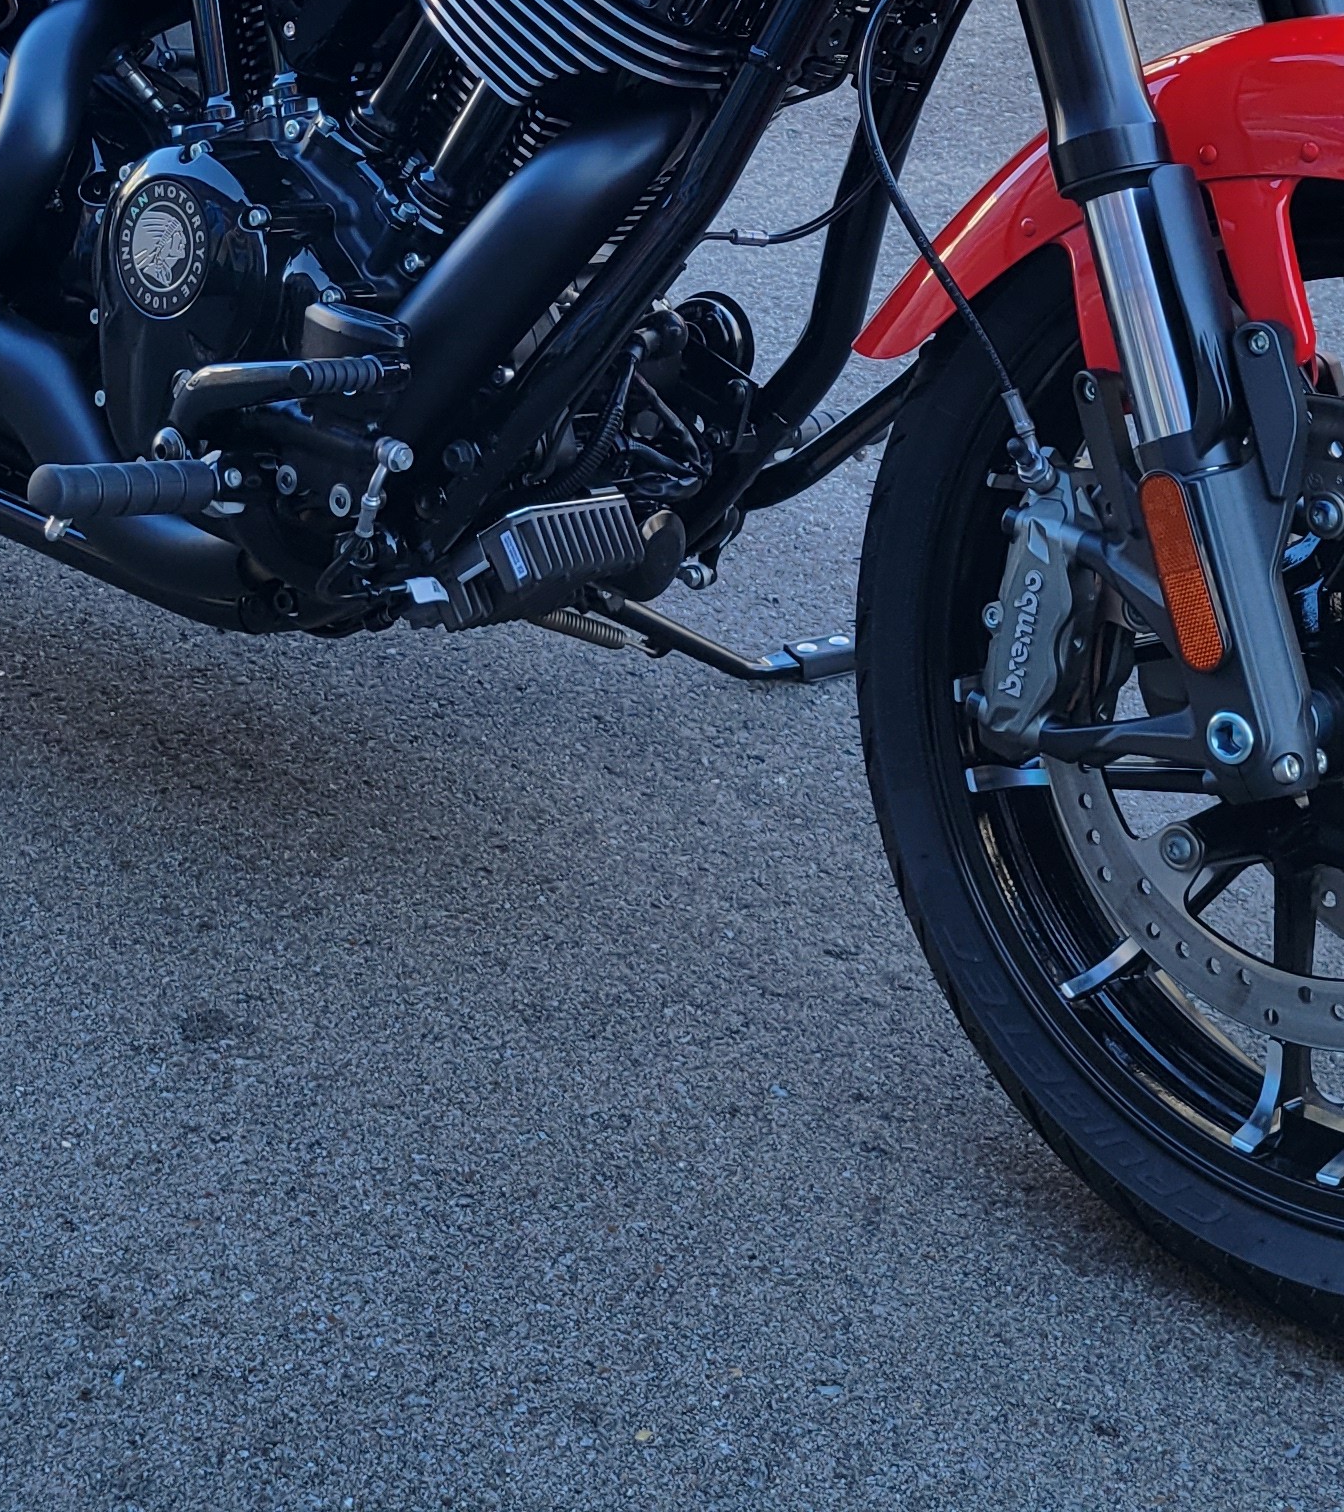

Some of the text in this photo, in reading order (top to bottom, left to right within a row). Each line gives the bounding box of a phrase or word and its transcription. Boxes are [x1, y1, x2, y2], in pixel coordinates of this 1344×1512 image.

[121, 192, 149, 271] INDIAN
[154, 184, 205, 298] MOTORCYCLE
[998, 569, 1044, 699] brembo
